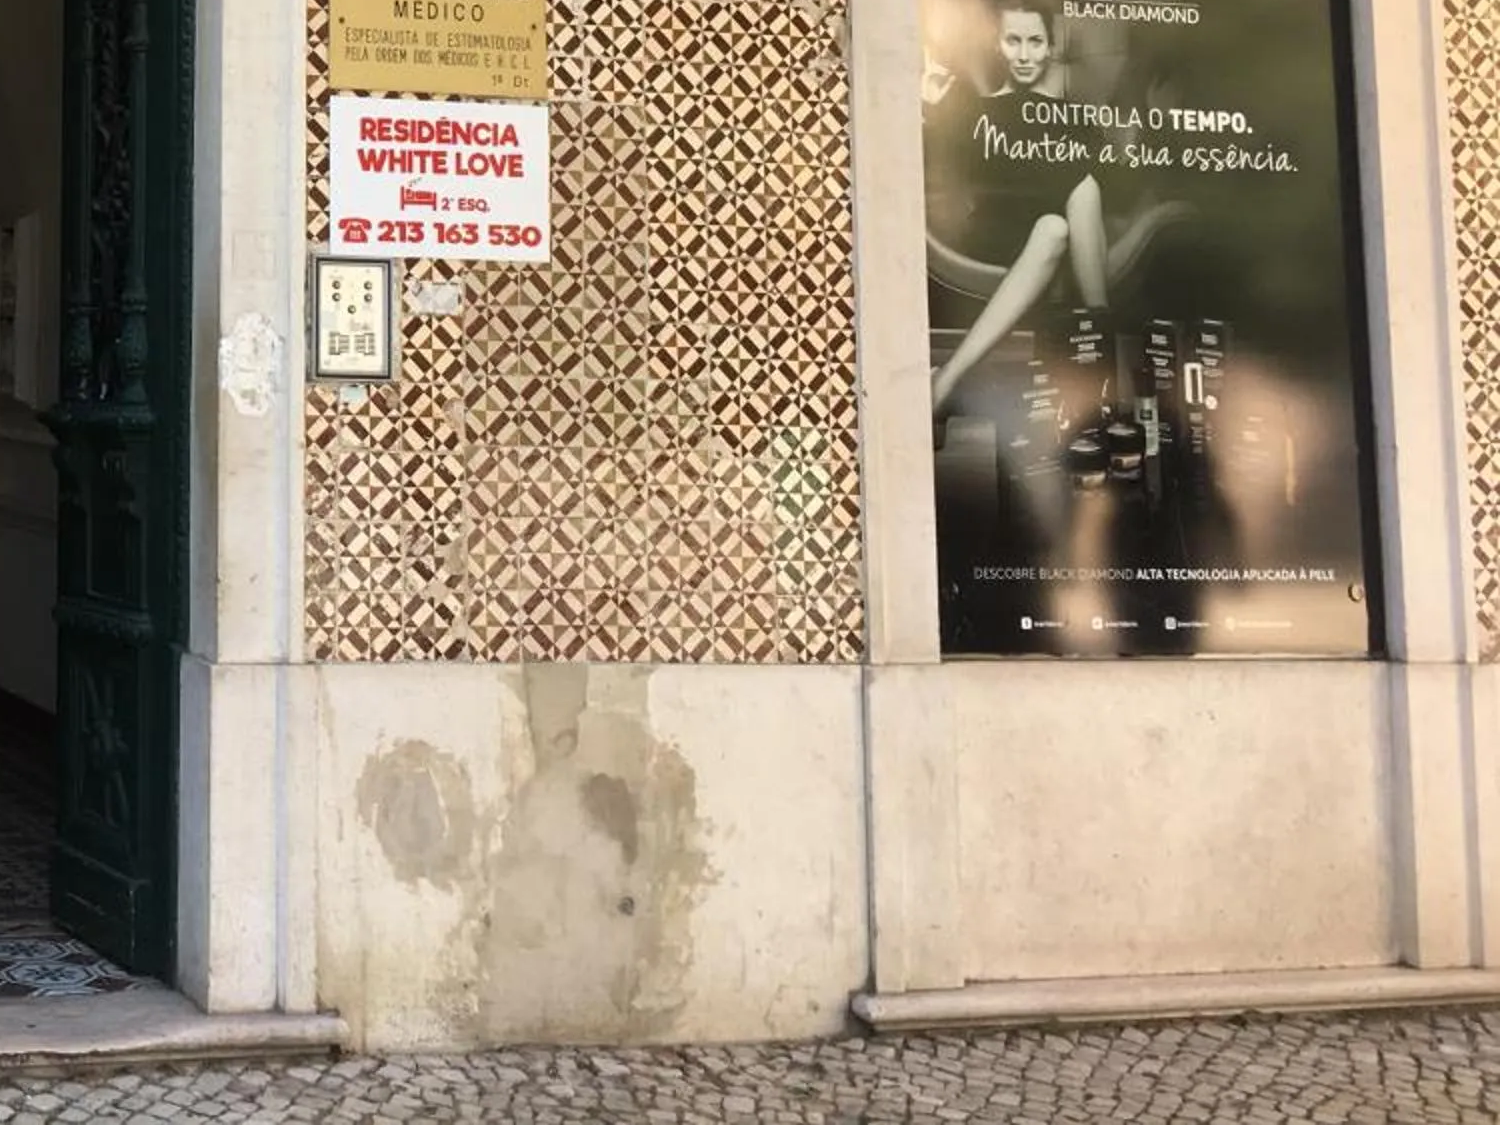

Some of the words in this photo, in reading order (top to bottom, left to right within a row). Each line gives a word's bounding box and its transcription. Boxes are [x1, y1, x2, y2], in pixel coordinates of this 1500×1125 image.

[1063, 0, 1116, 20] BLACK
[1120, 4, 1200, 24] DIAMOND
[345, 27, 419, 45] ESPECIALISTA
[426, 32, 439, 48] DE
[345, 45, 369, 62] PELA
[376, 48, 407, 64] ORDEM
[359, 116, 519, 147] RESIDÊNCIA
[1022, 102, 1143, 129] CONTROLA
[1149, 108, 1163, 130] O
[1168, 108, 1253, 134] TEMPO.
[973, 114, 1090, 162] Mantém
[1099, 143, 1117, 164] a
[1125, 141, 1174, 168] sua
[1181, 143, 1300, 172] essência.
[357, 148, 448, 174] WHITE
[455, 152, 525, 178] LOVE
[377, 219, 424, 243] 213
[433, 222, 478, 245] 163
[487, 224, 542, 248] 530
[974, 567, 1037, 580] DESCOBRE
[1078, 568, 1134, 580] DIAMOND
[1136, 568, 1162, 580] ALTA
[1165, 568, 1240, 581] TECNOLOGIA
[1243, 568, 1296, 581] APLICADA
[1309, 568, 1336, 581] PELE
